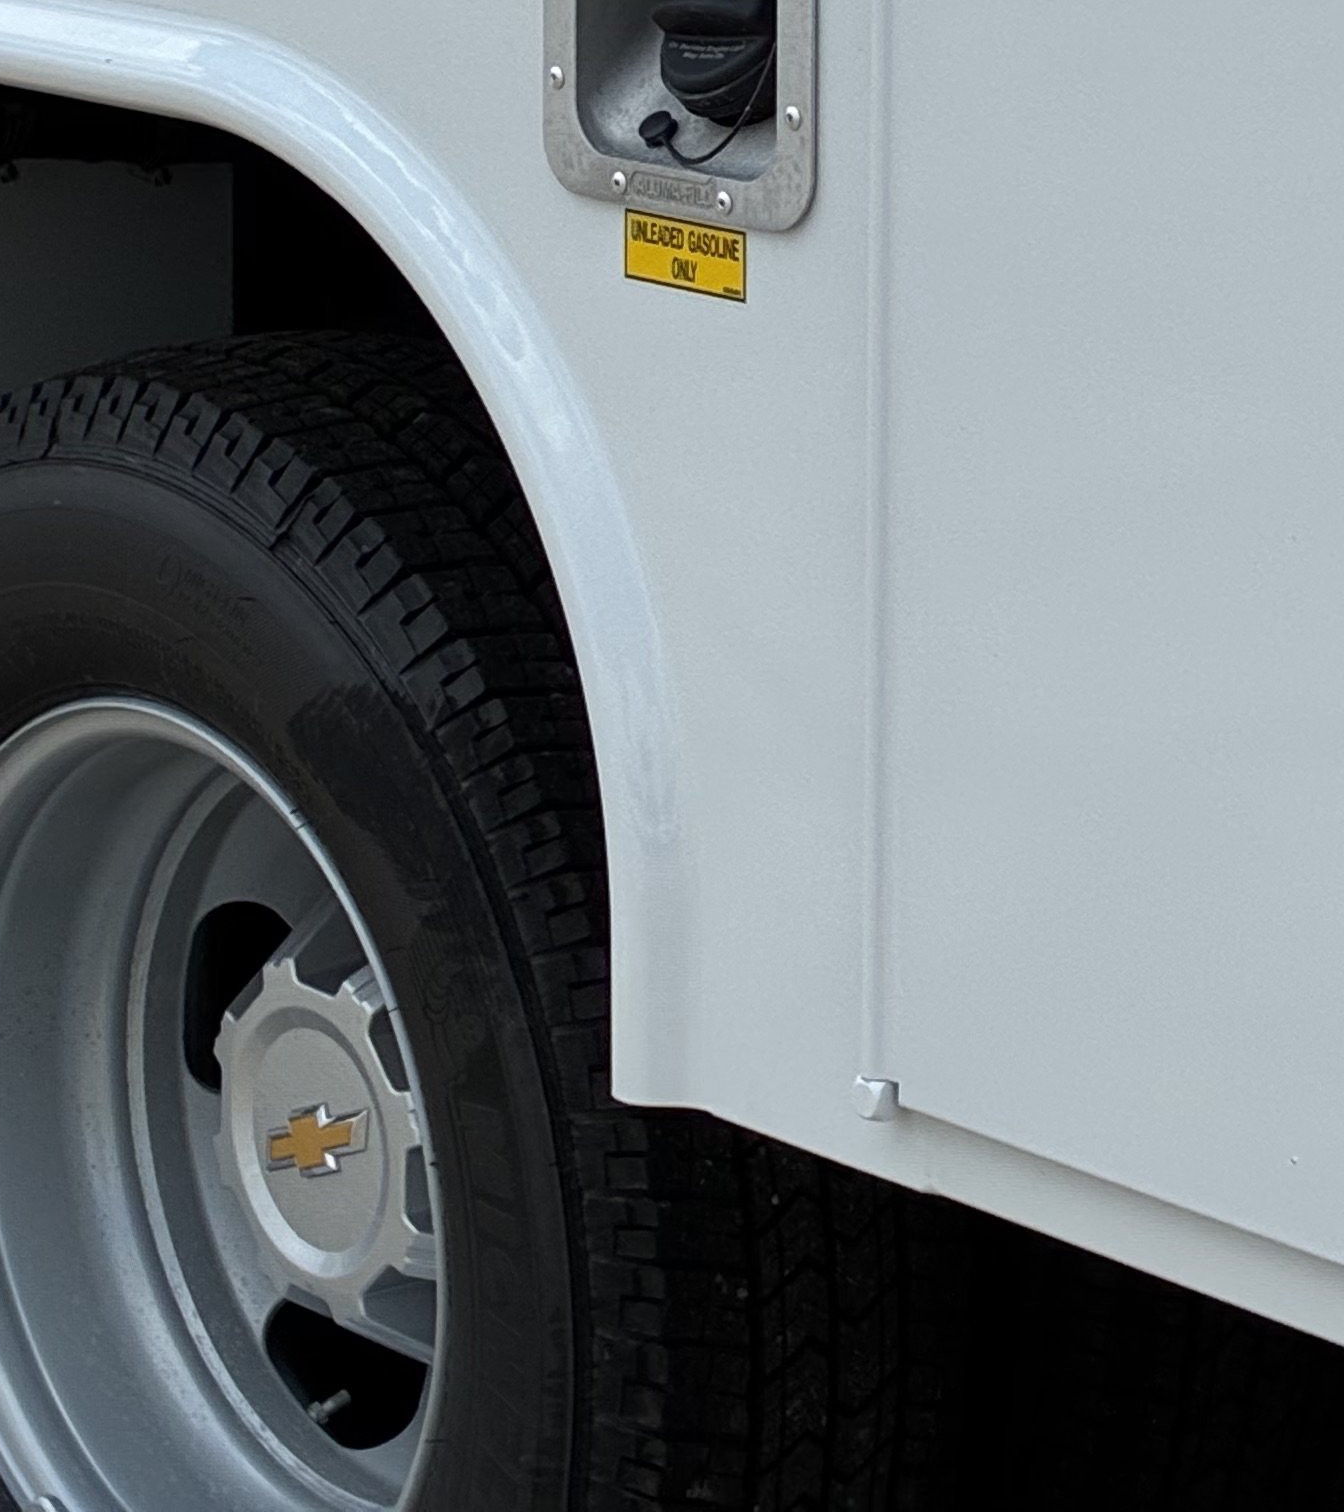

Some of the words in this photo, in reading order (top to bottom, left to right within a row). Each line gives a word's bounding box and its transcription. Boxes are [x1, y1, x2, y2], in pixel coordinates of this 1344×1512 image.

[630, 219, 684, 250] UNLEADED
[688, 229, 740, 262] GASOLINE
[672, 256, 697, 283] ONLY
